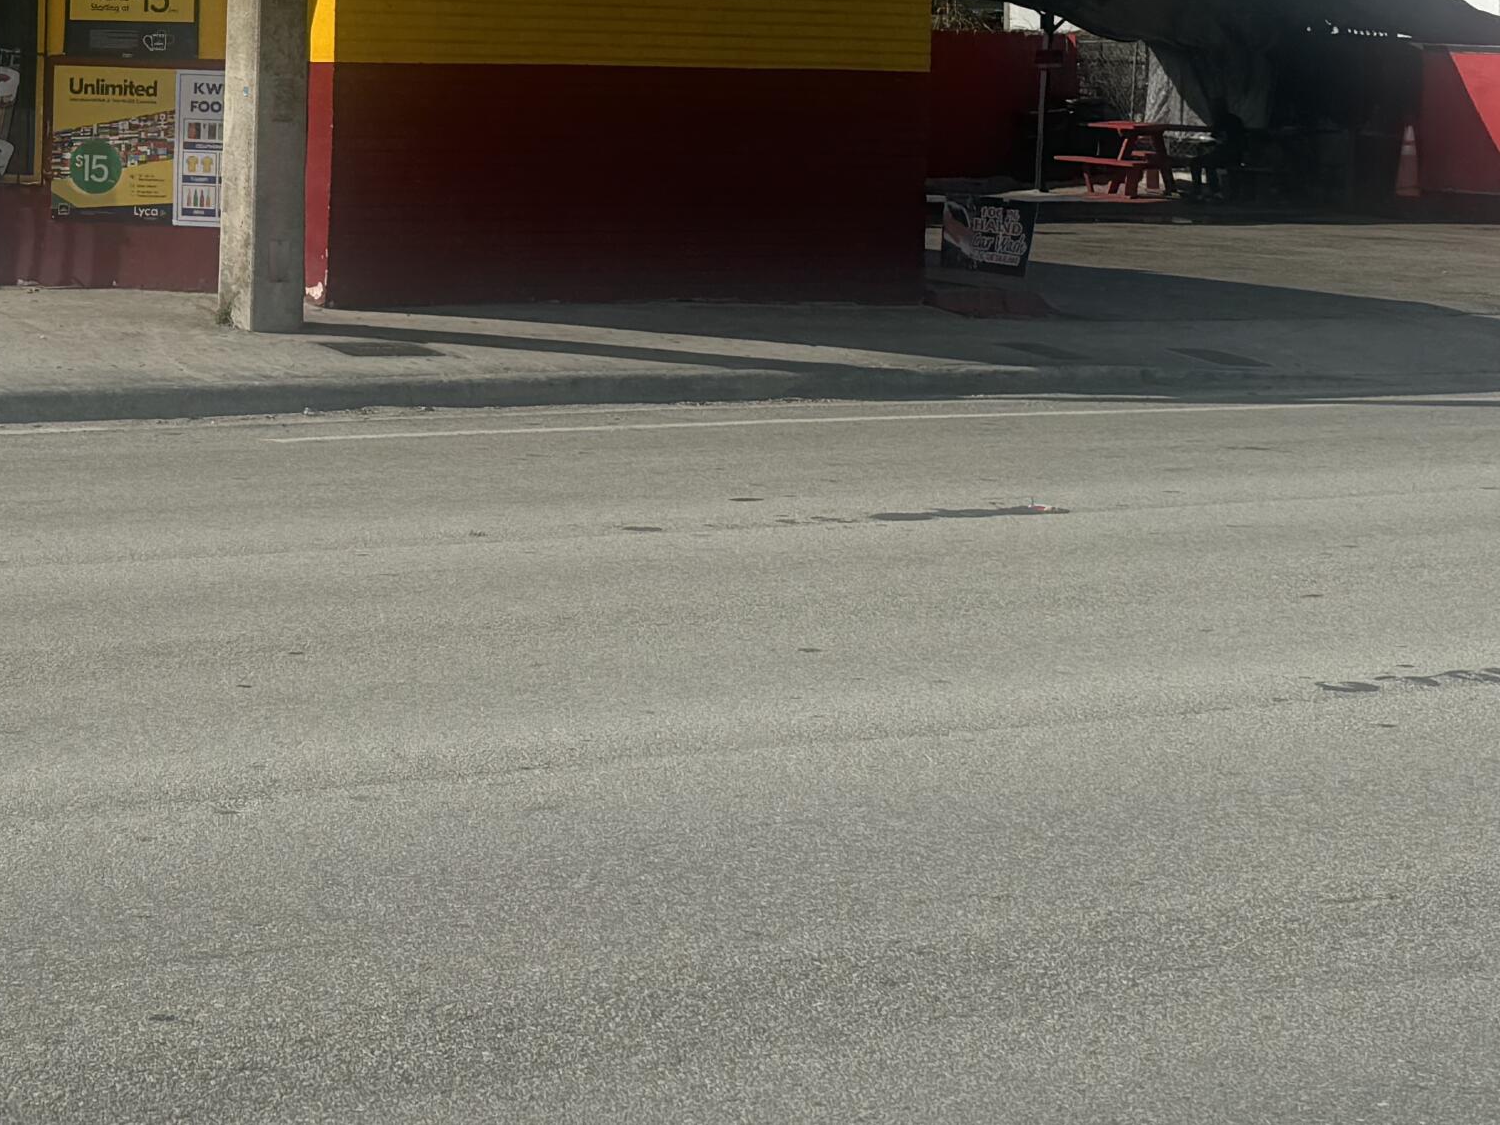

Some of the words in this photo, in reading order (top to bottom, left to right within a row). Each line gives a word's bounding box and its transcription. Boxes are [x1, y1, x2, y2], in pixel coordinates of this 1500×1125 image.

[91, 3, 119, 12] Starting
[69, 77, 158, 97] Unlimited
[194, 82, 222, 95] KW
[190, 101, 222, 113] FOO
[75, 154, 109, 183] $15
[133, 205, 158, 217] Lyca
[972, 217, 1023, 236] HAND
